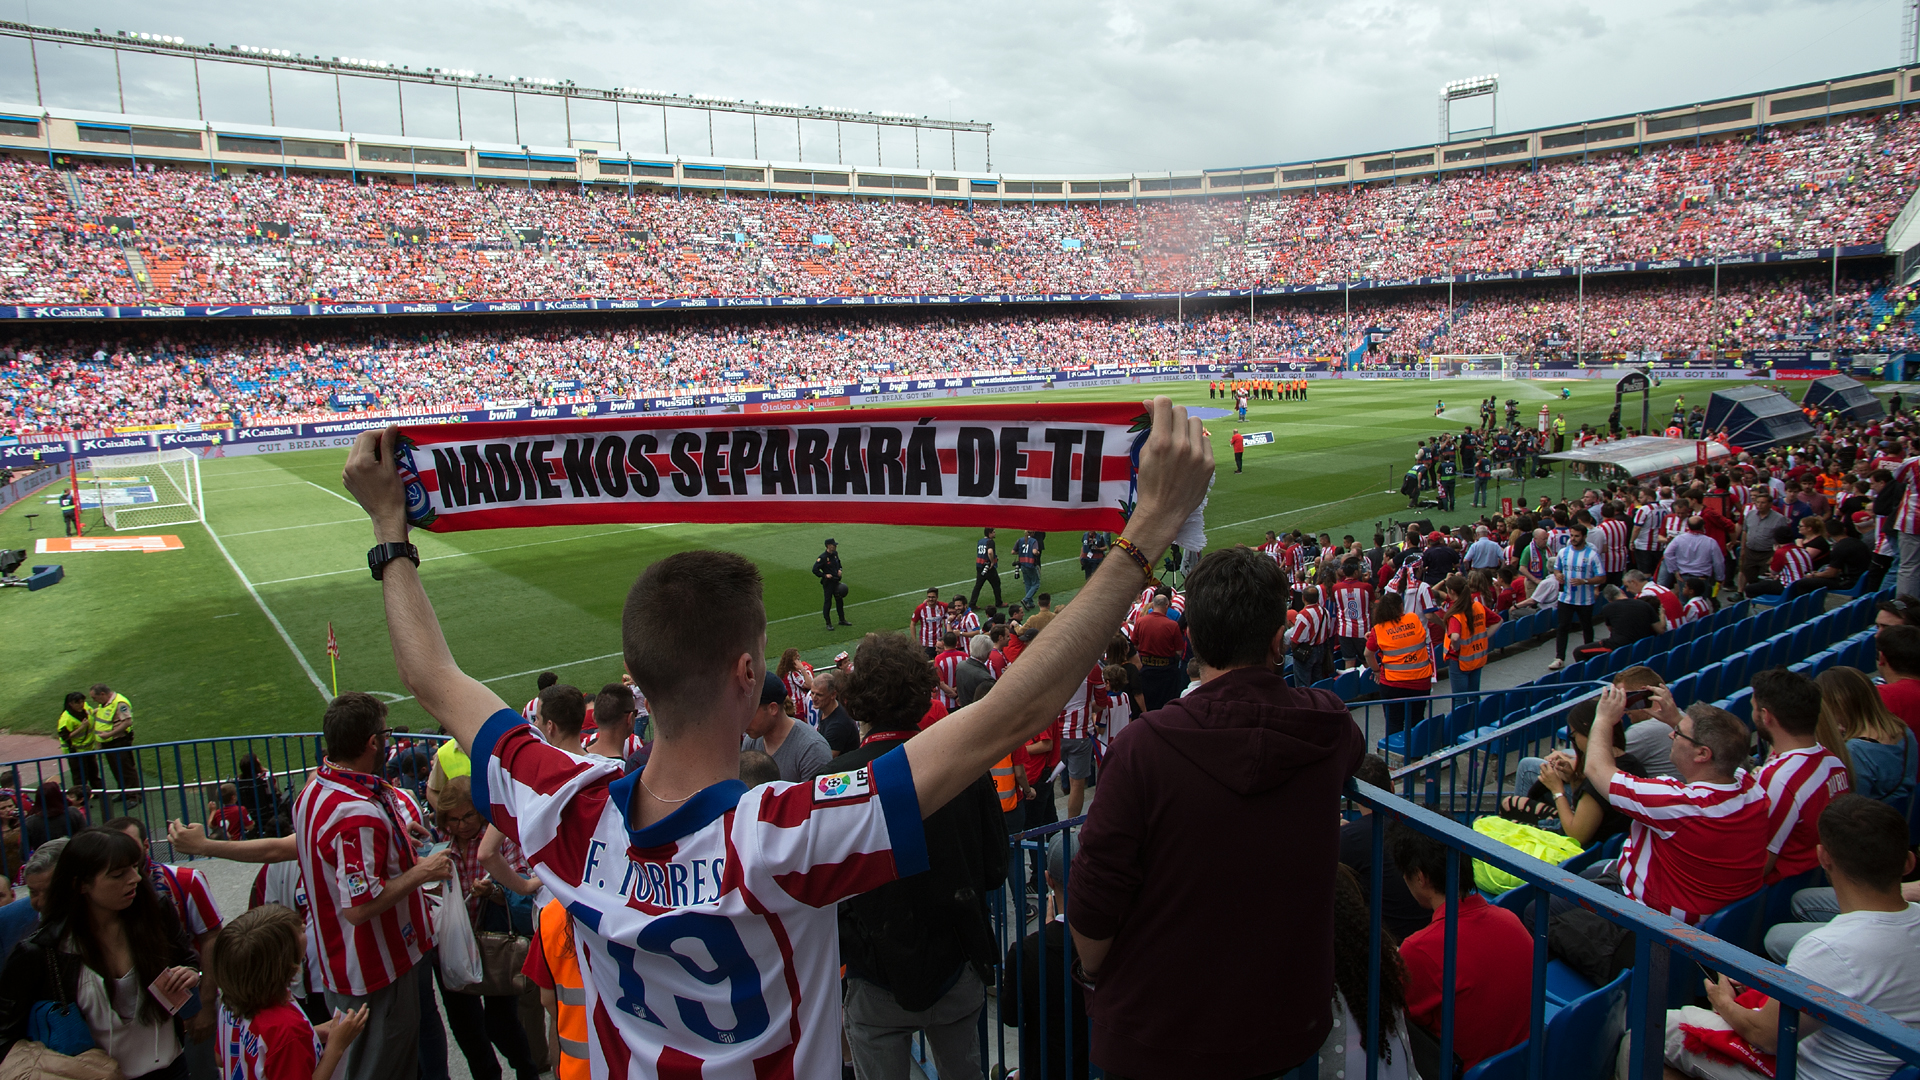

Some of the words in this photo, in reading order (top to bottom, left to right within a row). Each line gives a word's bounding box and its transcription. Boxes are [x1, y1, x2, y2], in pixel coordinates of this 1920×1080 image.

[1717, 255, 1754, 265] CaixaBank
[1781, 252, 1818, 261] Plus500
[1591, 264, 1625, 273] CaixaBank
[1648, 261, 1680, 270] Plus500
[1483, 272, 1513, 280] CaixaBank
[335, 305, 375, 314] CaixaBank
[554, 301, 588, 309] CaixaBank
[50, 307, 104, 317] CaixaBank
[141, 309, 185, 317] Plus500
[552, 381, 575, 389] Mahou
[917, 380, 936, 389] bwin
[944, 378, 963, 387] bwin
[860, 384, 880, 393] bw
[338, 394, 367, 402] Mahou
[543, 395, 594, 406] FABERO!
[711, 395, 747, 404] Plus500
[763, 391, 797, 400] Plus500
[610, 400, 635, 411] bwin
[656, 399, 693, 408] Plus500
[769, 402, 791, 411] LaLiga
[802, 399, 836, 409] Satander
[488, 408, 517, 421] bwin
[531, 405, 558, 417] bwin
[257, 416, 279, 426] Peña
[251, 426, 293, 438] CaixaBank
[97, 437, 147, 448] CaixaBank
[176, 432, 222, 443] CaixaBank
[257, 443, 285, 453] CUT.
[289, 439, 330, 450] BREAK.
[333, 437, 357, 446] GOT
[432, 440, 562, 509] NADIE
[563, 434, 660, 498] NOS
[670, 417, 943, 498] SEPARARÁ
[957, 426, 1030, 500] DE
[1045, 427, 1104, 502] TI
[1347, 600, 1359, 620] 8
[1385, 622, 1416, 636] VOLUNTARIO
[1472, 642, 1484, 652] 181
[856, 769, 868, 787] LFP
[583, 838, 607, 889] F.
[617, 852, 726, 908] TORRES
[353, 885, 365, 895] LFP
[565, 900, 771, 1044] 19
